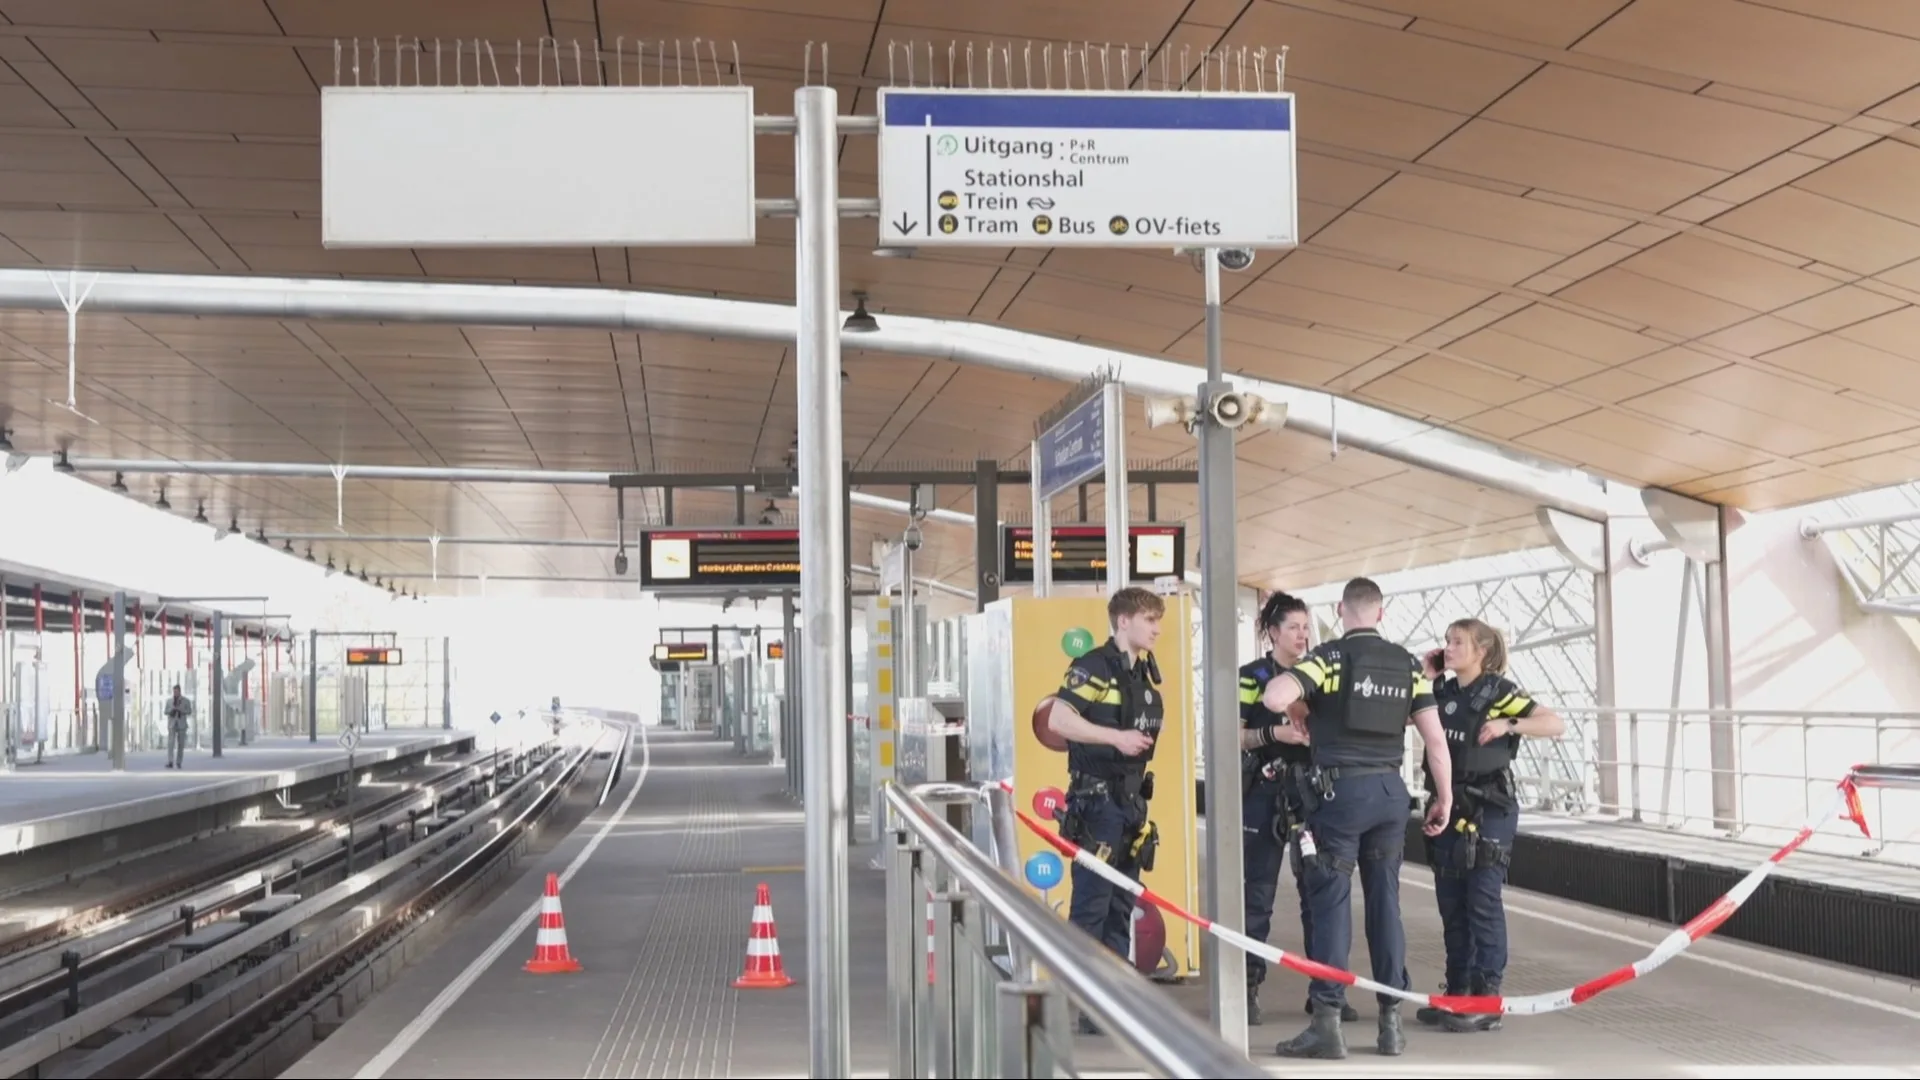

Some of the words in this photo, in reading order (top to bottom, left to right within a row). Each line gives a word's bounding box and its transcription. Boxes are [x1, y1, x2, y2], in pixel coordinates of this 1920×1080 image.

[964, 136, 1053, 158] Uitgang
[1070, 139, 1096, 150] P+R
[1070, 153, 1129, 165] Centrum
[964, 169, 1084, 187] Stationshal
[964, 192, 1018, 210] Trein
[964, 215, 1018, 234] Tram
[1059, 217, 1095, 234] Bus
[1135, 216, 1221, 235] OV-fiets
[1072, 637, 1083, 650] m
[1353, 675, 1407, 698] POLITIE
[1043, 797, 1056, 810] m
[1038, 863, 1052, 876] m
